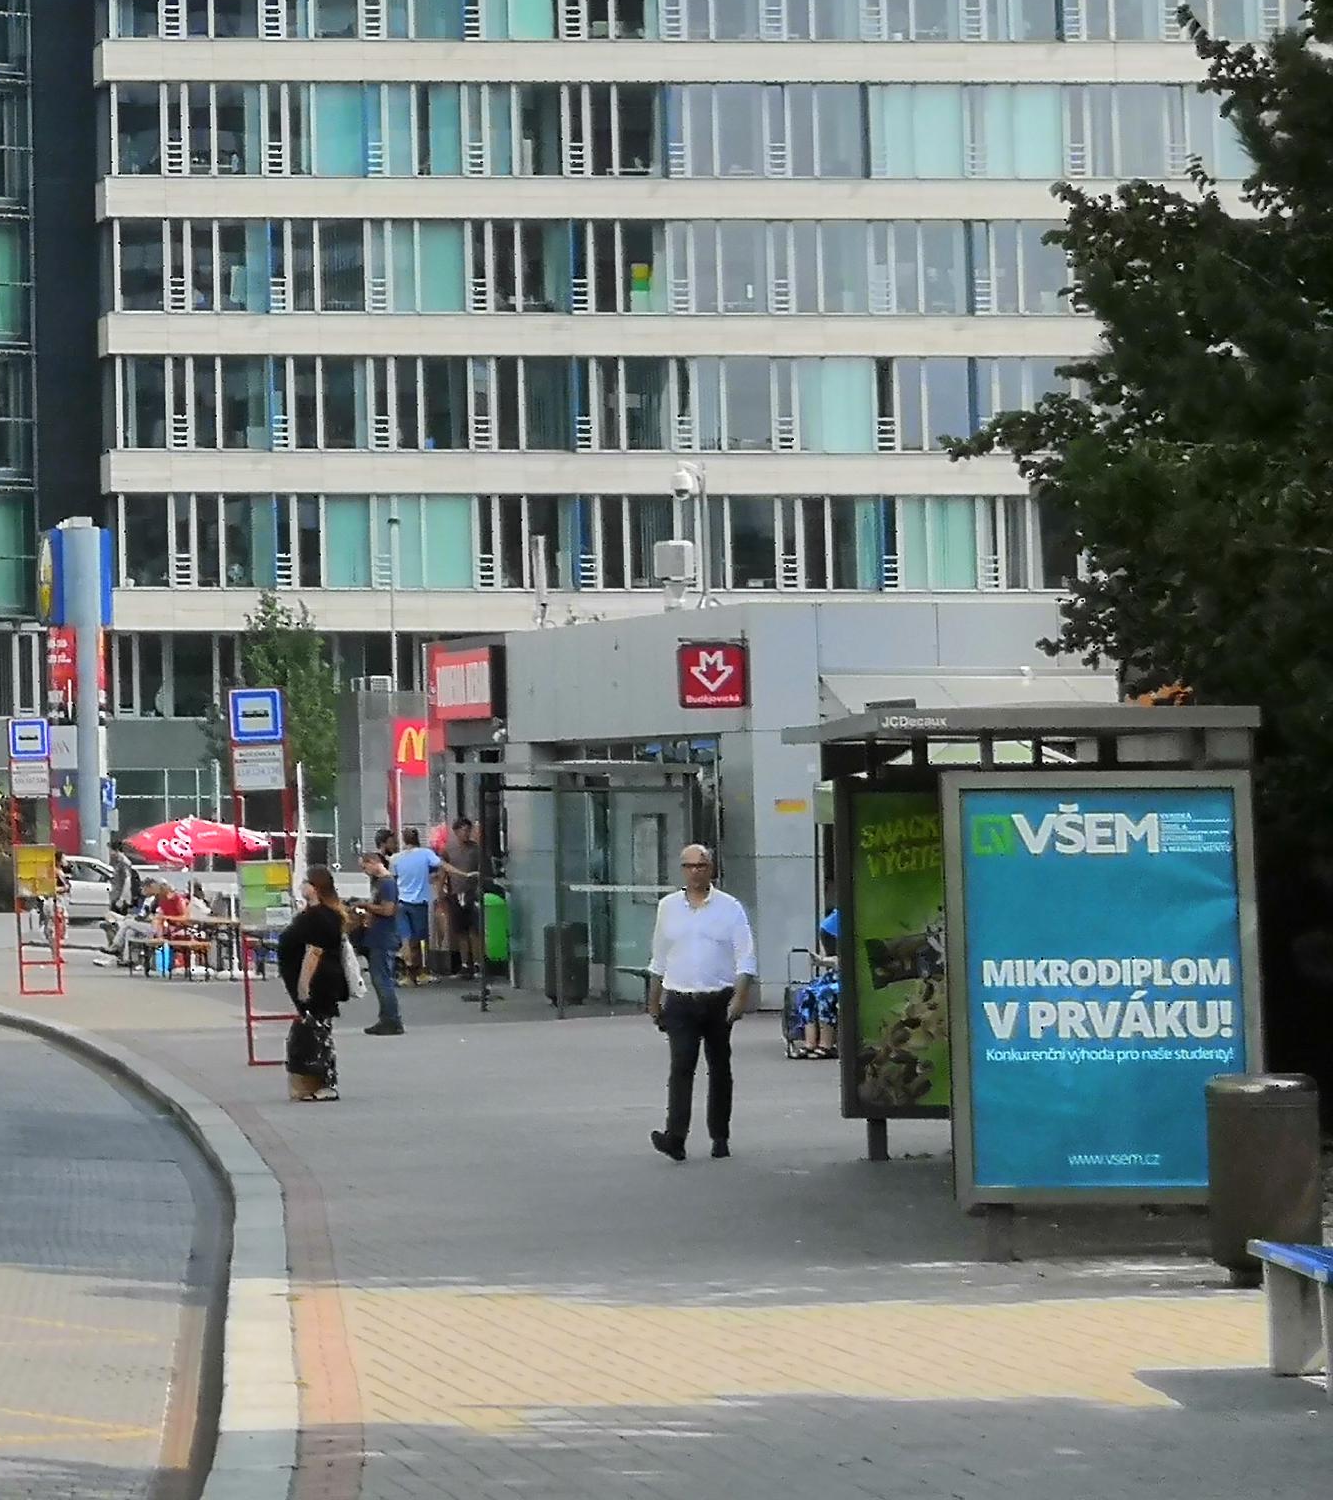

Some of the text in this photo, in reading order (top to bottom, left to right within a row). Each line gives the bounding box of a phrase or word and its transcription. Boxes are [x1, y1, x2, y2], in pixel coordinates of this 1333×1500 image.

[686, 694, 740, 704] Budějovická
[882, 716, 947, 728] JCDecaux
[1011, 803, 1161, 854] VŠEM
[983, 958, 1230, 986] MIKRODIPLOM
[984, 990, 1233, 1039] V PRVÁKU!
[986, 1047, 1234, 1064] Konkurenční výhoda pro naše studenty!
[1067, 1154, 1161, 1166] www.vsem.cz
